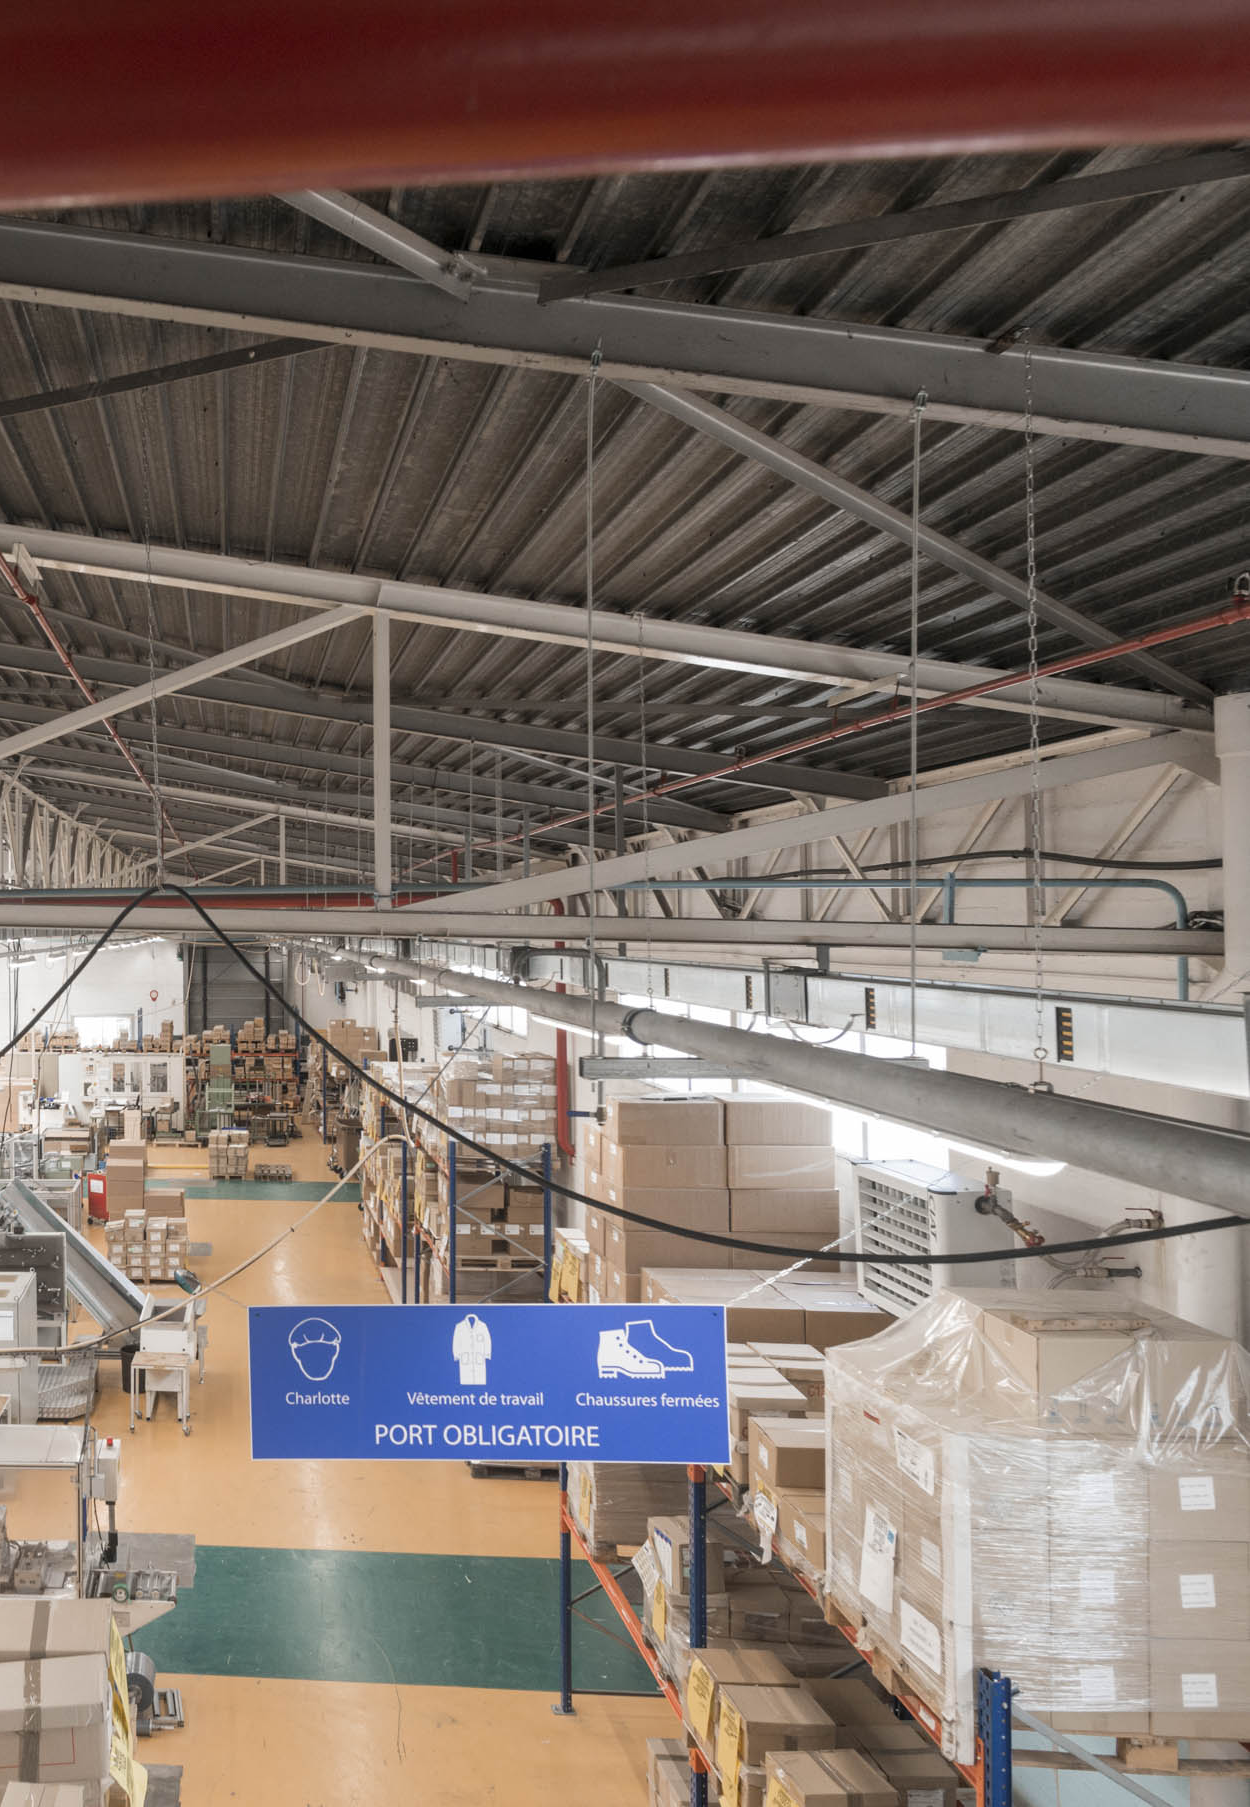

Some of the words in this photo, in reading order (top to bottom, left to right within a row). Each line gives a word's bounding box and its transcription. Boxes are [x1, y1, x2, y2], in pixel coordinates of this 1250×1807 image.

[285, 1391, 350, 1405] Charlotte
[407, 1391, 476, 1405] Vêtement
[478, 1391, 498, 1405] de
[500, 1391, 544, 1406] travail
[576, 1392, 658, 1407] Chaussures
[660, 1393, 720, 1408] fermées
[375, 1424, 438, 1445] PORT
[443, 1424, 600, 1447] OBLIGATOIRE
